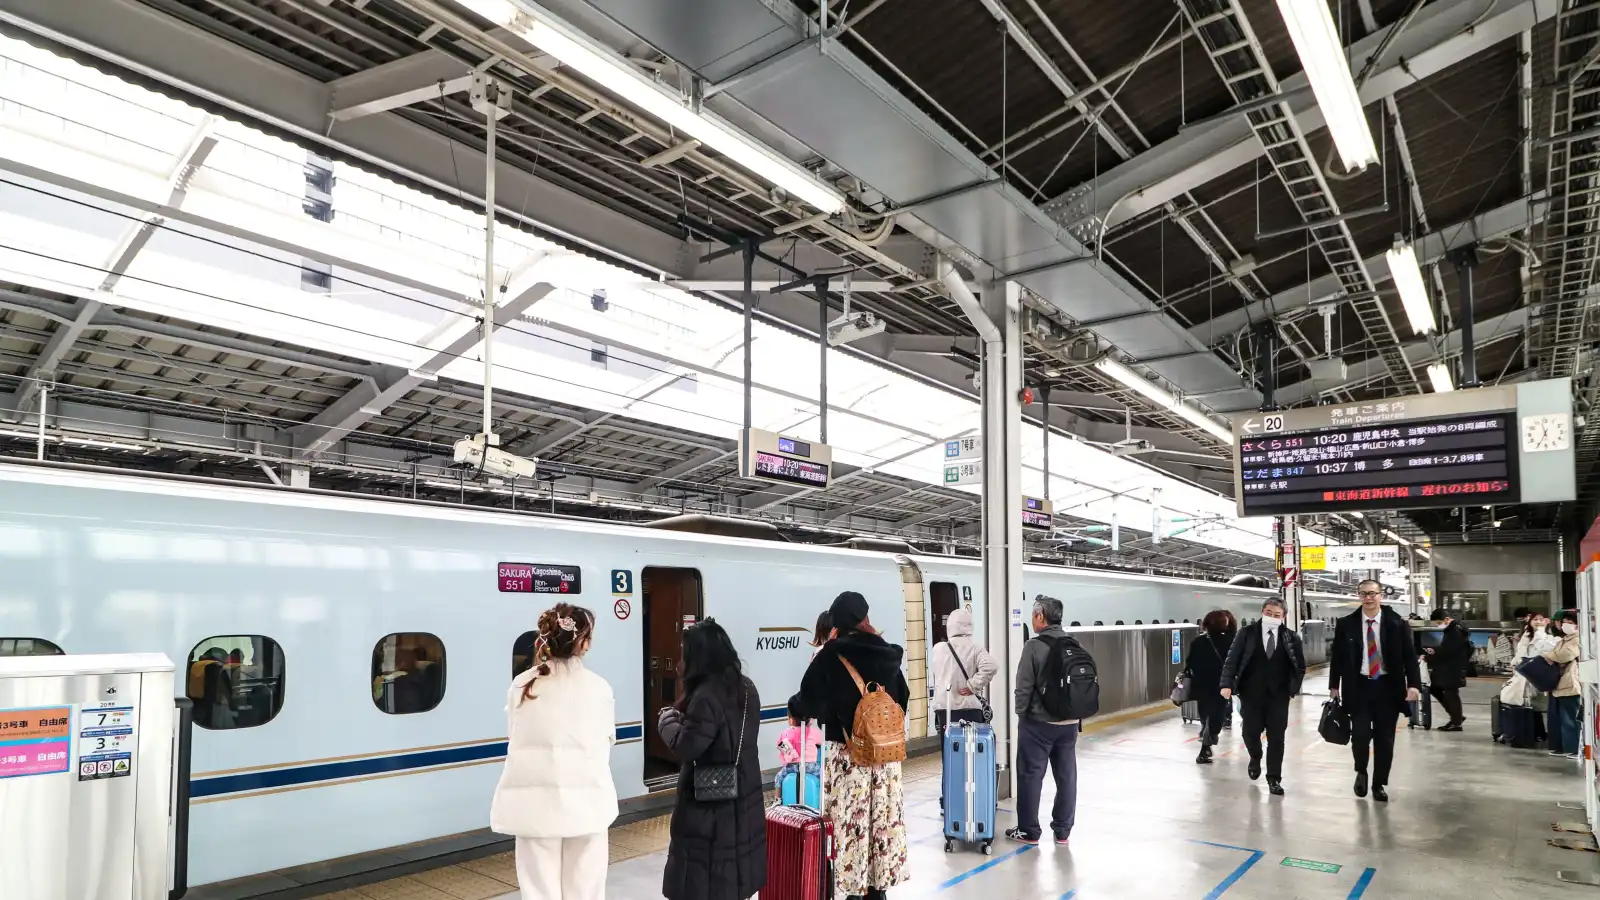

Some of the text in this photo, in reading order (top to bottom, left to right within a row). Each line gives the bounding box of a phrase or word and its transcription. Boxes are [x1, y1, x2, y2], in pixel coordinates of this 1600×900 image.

[1331, 403, 1404, 417] 発車ご案内
[1265, 417, 1282, 430] 20
[1331, 417, 1352, 425] Train
[1242, 440, 1281, 452] さくら
[1286, 438, 1303, 447] 551
[1313, 434, 1347, 445] 10:20
[1353, 428, 1400, 441] 鹿児島中央
[757, 454, 775, 464] SAKURA
[784, 459, 799, 469] 10:20
[1244, 468, 1282, 479] こだま
[1287, 467, 1304, 476] 847
[1314, 463, 1348, 474] 10:37
[1336, 486, 1409, 500] 東海道新幹線
[499, 566, 563, 579] SAKURA Kagoshima-
[506, 579, 548, 590] 551 Non-
[616, 571, 627, 592] 3
[535, 585, 560, 593] Reserved
[965, 586, 970, 600] 4
[756, 636, 800, 650] KYUSHU
[39, 717, 68, 727] 自由席
[97, 713, 107, 726] 7
[96, 737, 106, 749] 3
[37, 751, 67, 761] 自由席
